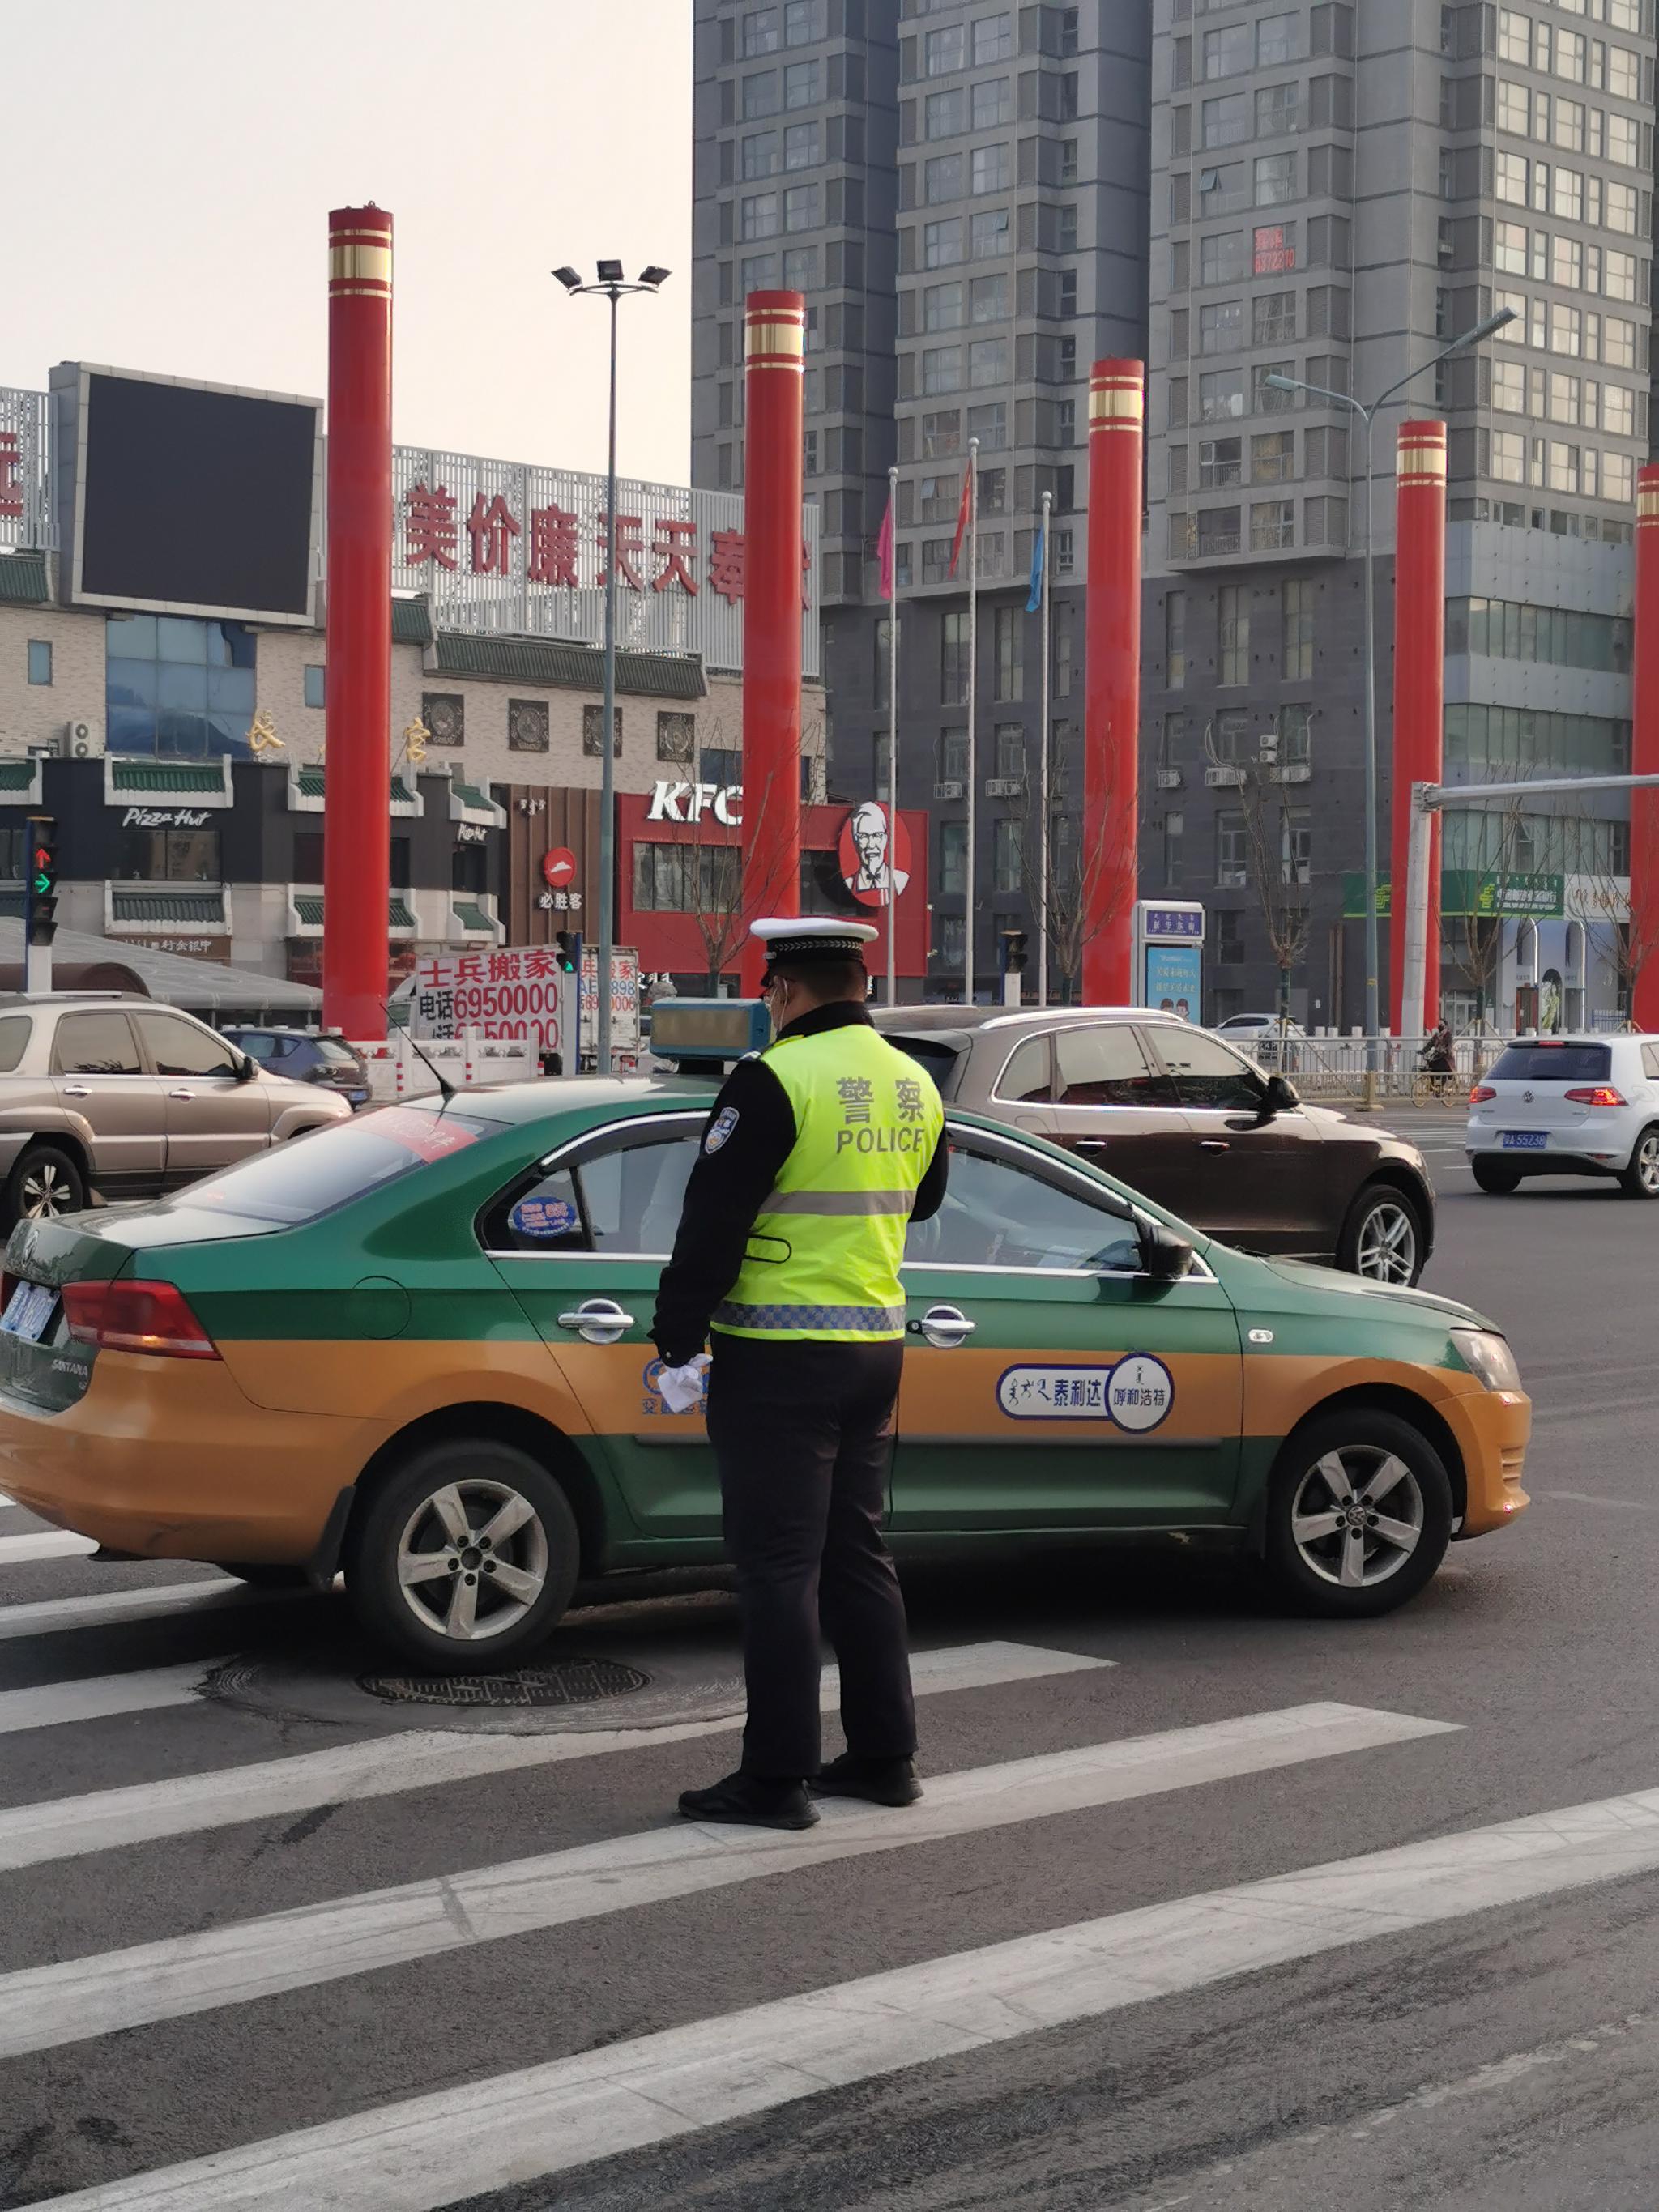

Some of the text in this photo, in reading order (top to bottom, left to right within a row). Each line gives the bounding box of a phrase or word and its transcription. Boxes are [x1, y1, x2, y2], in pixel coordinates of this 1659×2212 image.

[393, 484, 809, 610] 美价廉天天奉
[122, 808, 212, 826] Pizza Hut
[647, 780, 744, 825] KFC
[539, 893, 582, 909] 必胜客
[420, 951, 556, 987] 士兵搬家
[836, 1076, 925, 1125] 警察
[837, 1127, 925, 1154] POLICE
[1054, 1379, 1102, 1407] 泰利达
[1113, 1387, 1166, 1407] 呼和浩特
